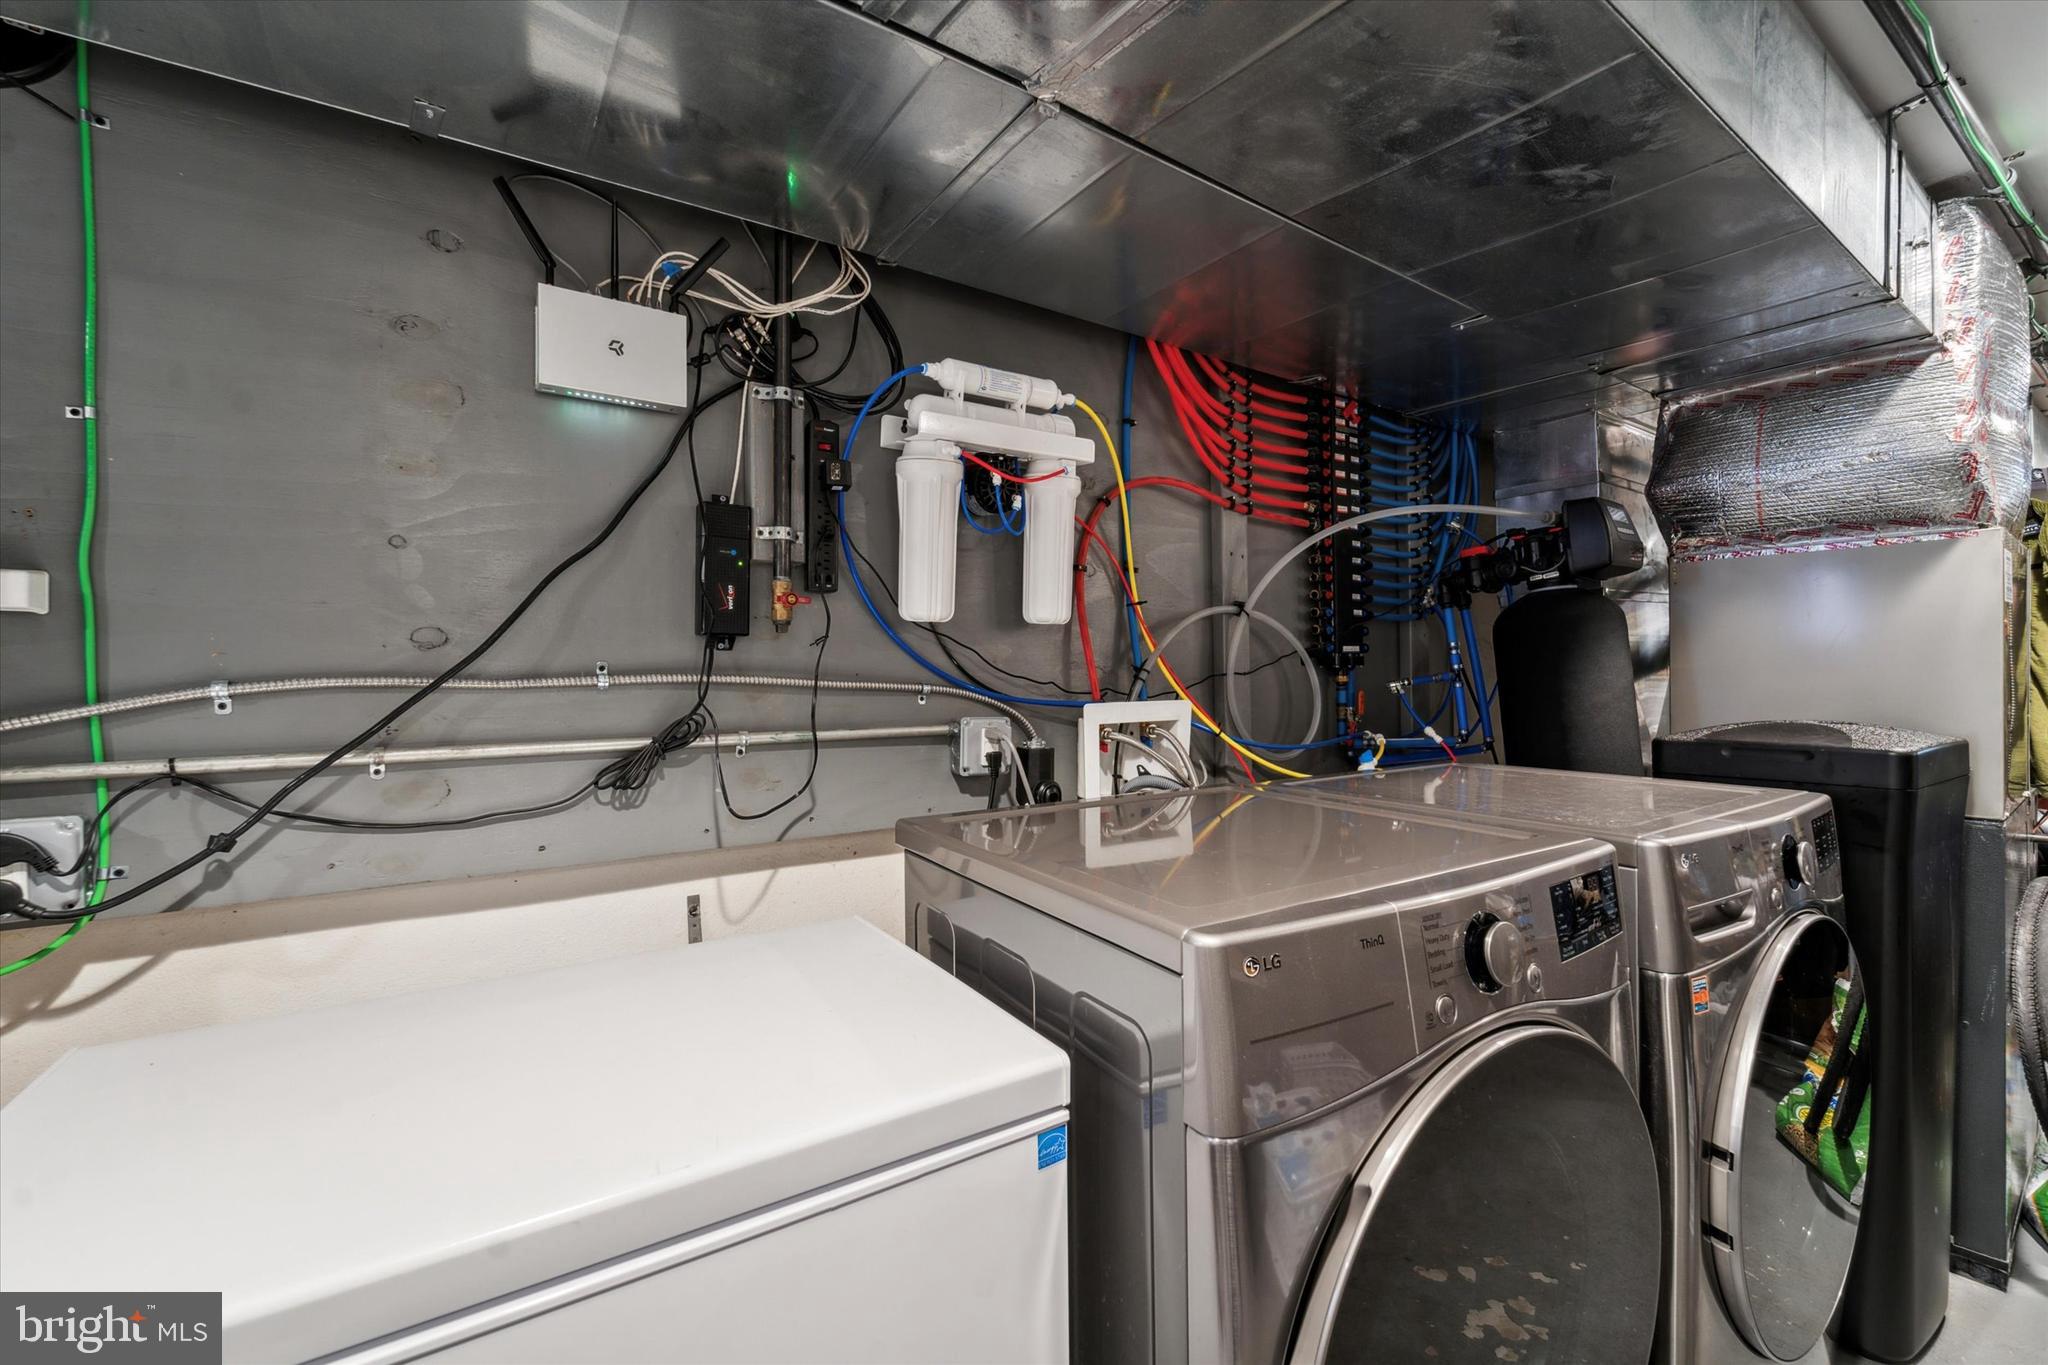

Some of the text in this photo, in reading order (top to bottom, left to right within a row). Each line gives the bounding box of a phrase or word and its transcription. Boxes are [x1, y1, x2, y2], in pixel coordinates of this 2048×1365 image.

[727, 585, 735, 609] verizon
[1360, 934, 1385, 949] ThinQ
[1263, 953, 1281, 972] LG
